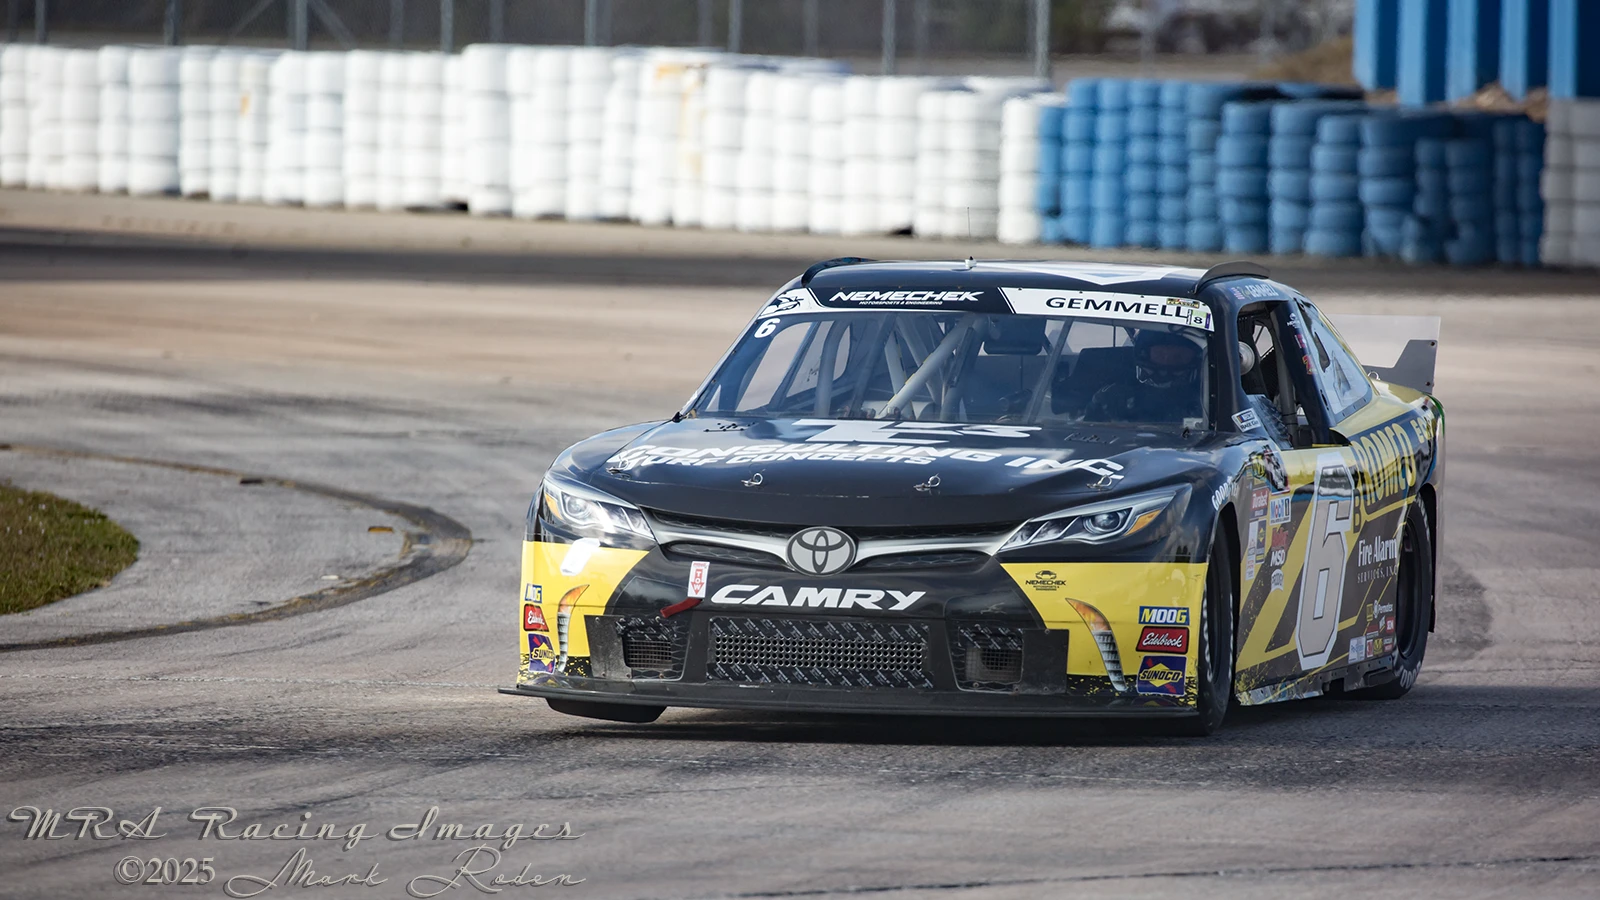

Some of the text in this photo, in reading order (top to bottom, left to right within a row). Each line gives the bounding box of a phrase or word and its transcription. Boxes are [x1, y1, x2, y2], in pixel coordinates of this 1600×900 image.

[829, 290, 984, 303] NEMECHEK
[1045, 297, 1188, 318] GEMMELL
[754, 317, 781, 339] 6
[1193, 316, 1203, 324] 8
[606, 444, 1002, 463] CONSULTING
[621, 452, 937, 471] TURF CONCEPTS
[1270, 549, 1287, 568] MSD
[1357, 535, 1398, 567] Fire Alarm
[1295, 451, 1356, 671] 6
[711, 584, 927, 611] CAMRY
[1140, 608, 1187, 624] MOOG
[1142, 632, 1183, 648] Edelbrock
[1140, 669, 1181, 681] SUNOCO
